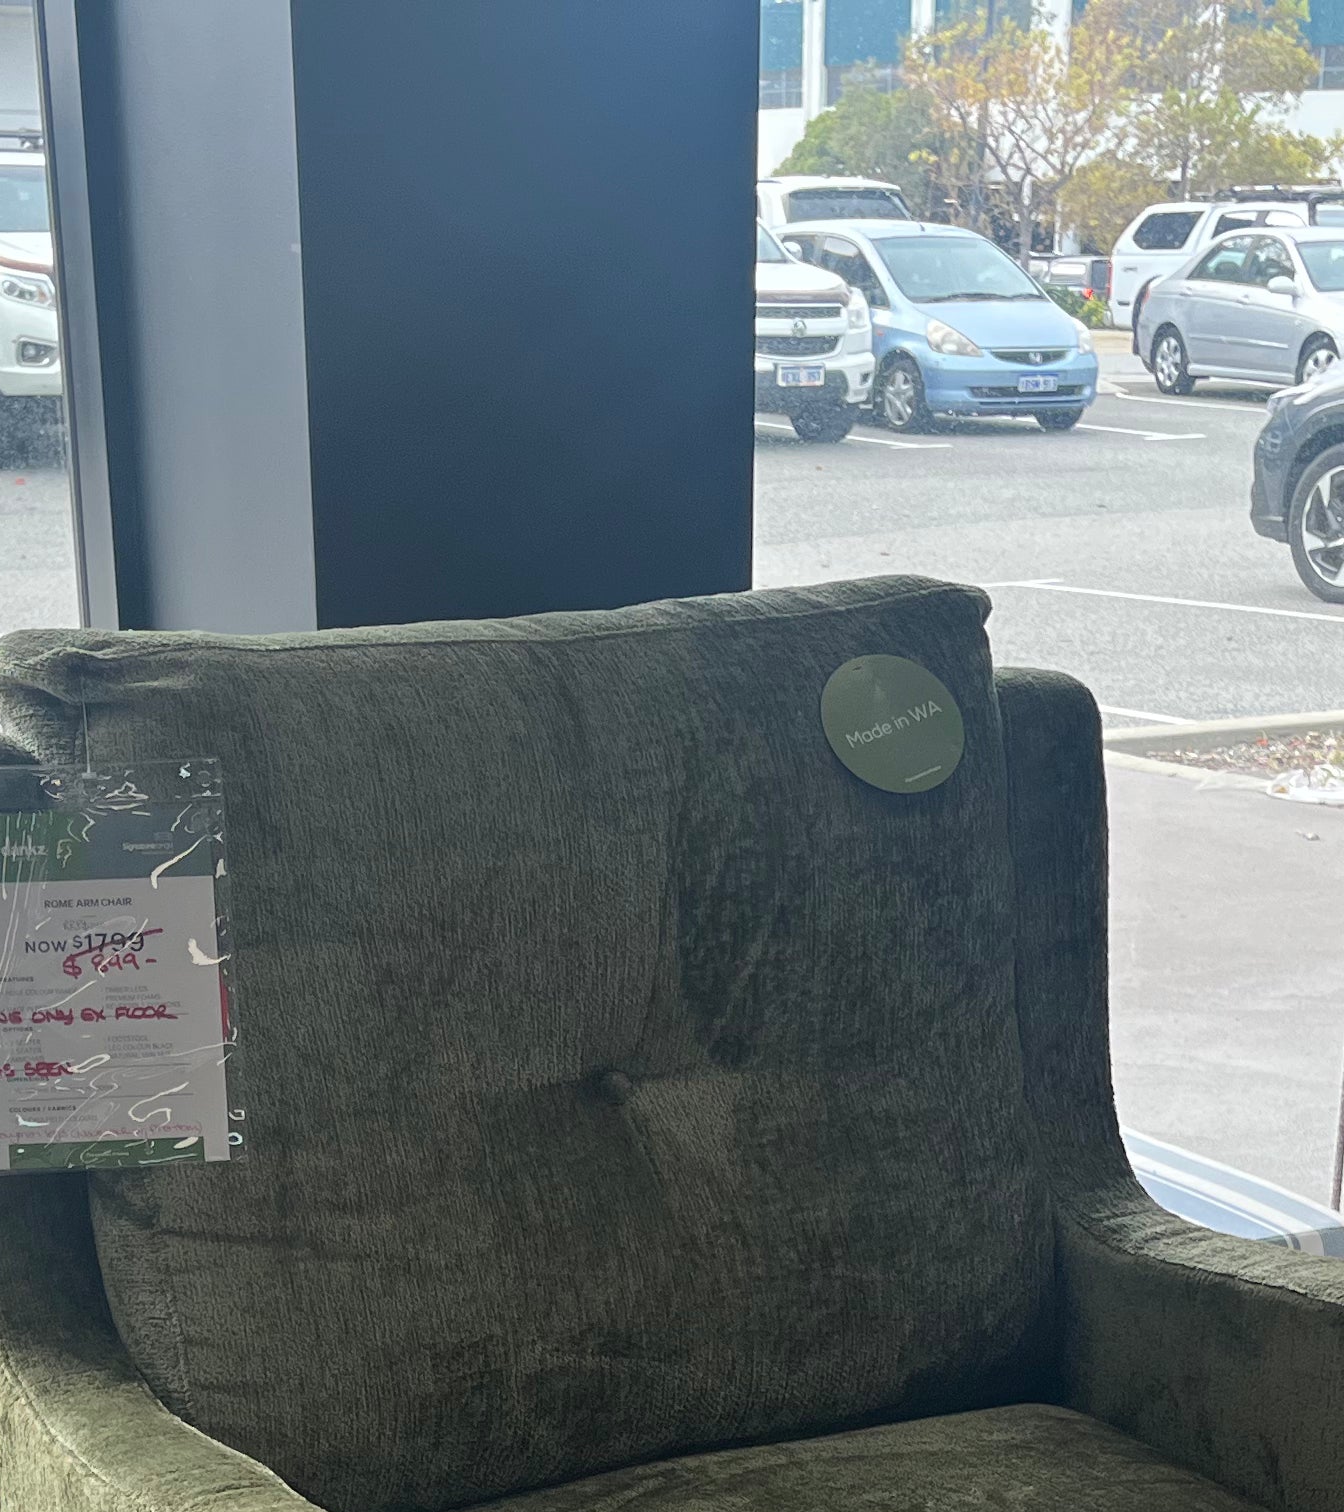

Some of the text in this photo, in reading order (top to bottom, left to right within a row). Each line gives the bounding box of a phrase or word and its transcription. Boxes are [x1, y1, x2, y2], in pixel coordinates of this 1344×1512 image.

[845, 700, 943, 748] Made in WA
[44, 900, 73, 908] ROME
[25, 941, 67, 953] NOW
[81, 1007, 106, 1022] EX
[115, 1004, 178, 1020] FLOOR
[24, 1062, 73, 1077] SEEN
